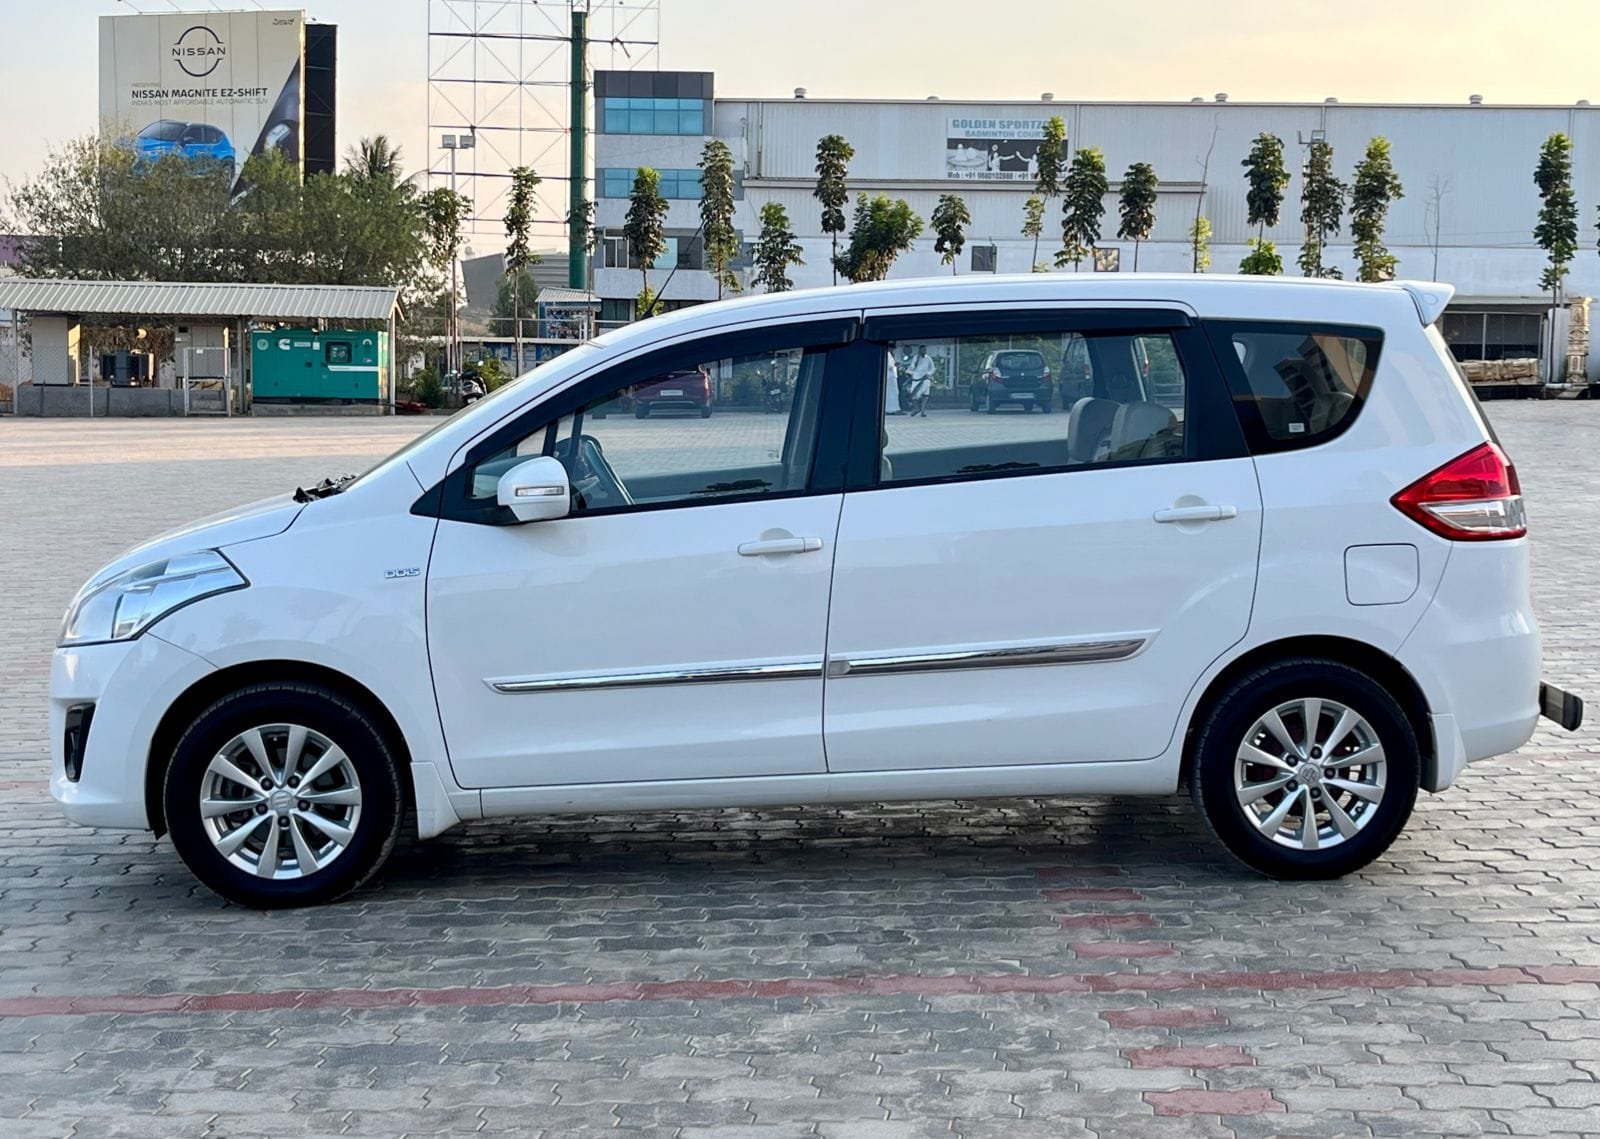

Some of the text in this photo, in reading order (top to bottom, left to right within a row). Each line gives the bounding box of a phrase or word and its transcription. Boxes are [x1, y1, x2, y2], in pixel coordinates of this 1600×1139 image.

[172, 47, 226, 56] NISSAN
[131, 87, 268, 99] NISSAN MAGNITE EZ-SHIFT
[216, 97, 253, 105] AUTOMATIC
[255, 97, 269, 105] SUV
[953, 119, 995, 129] GOLDEN
[965, 130, 1015, 138] BADMINTON
